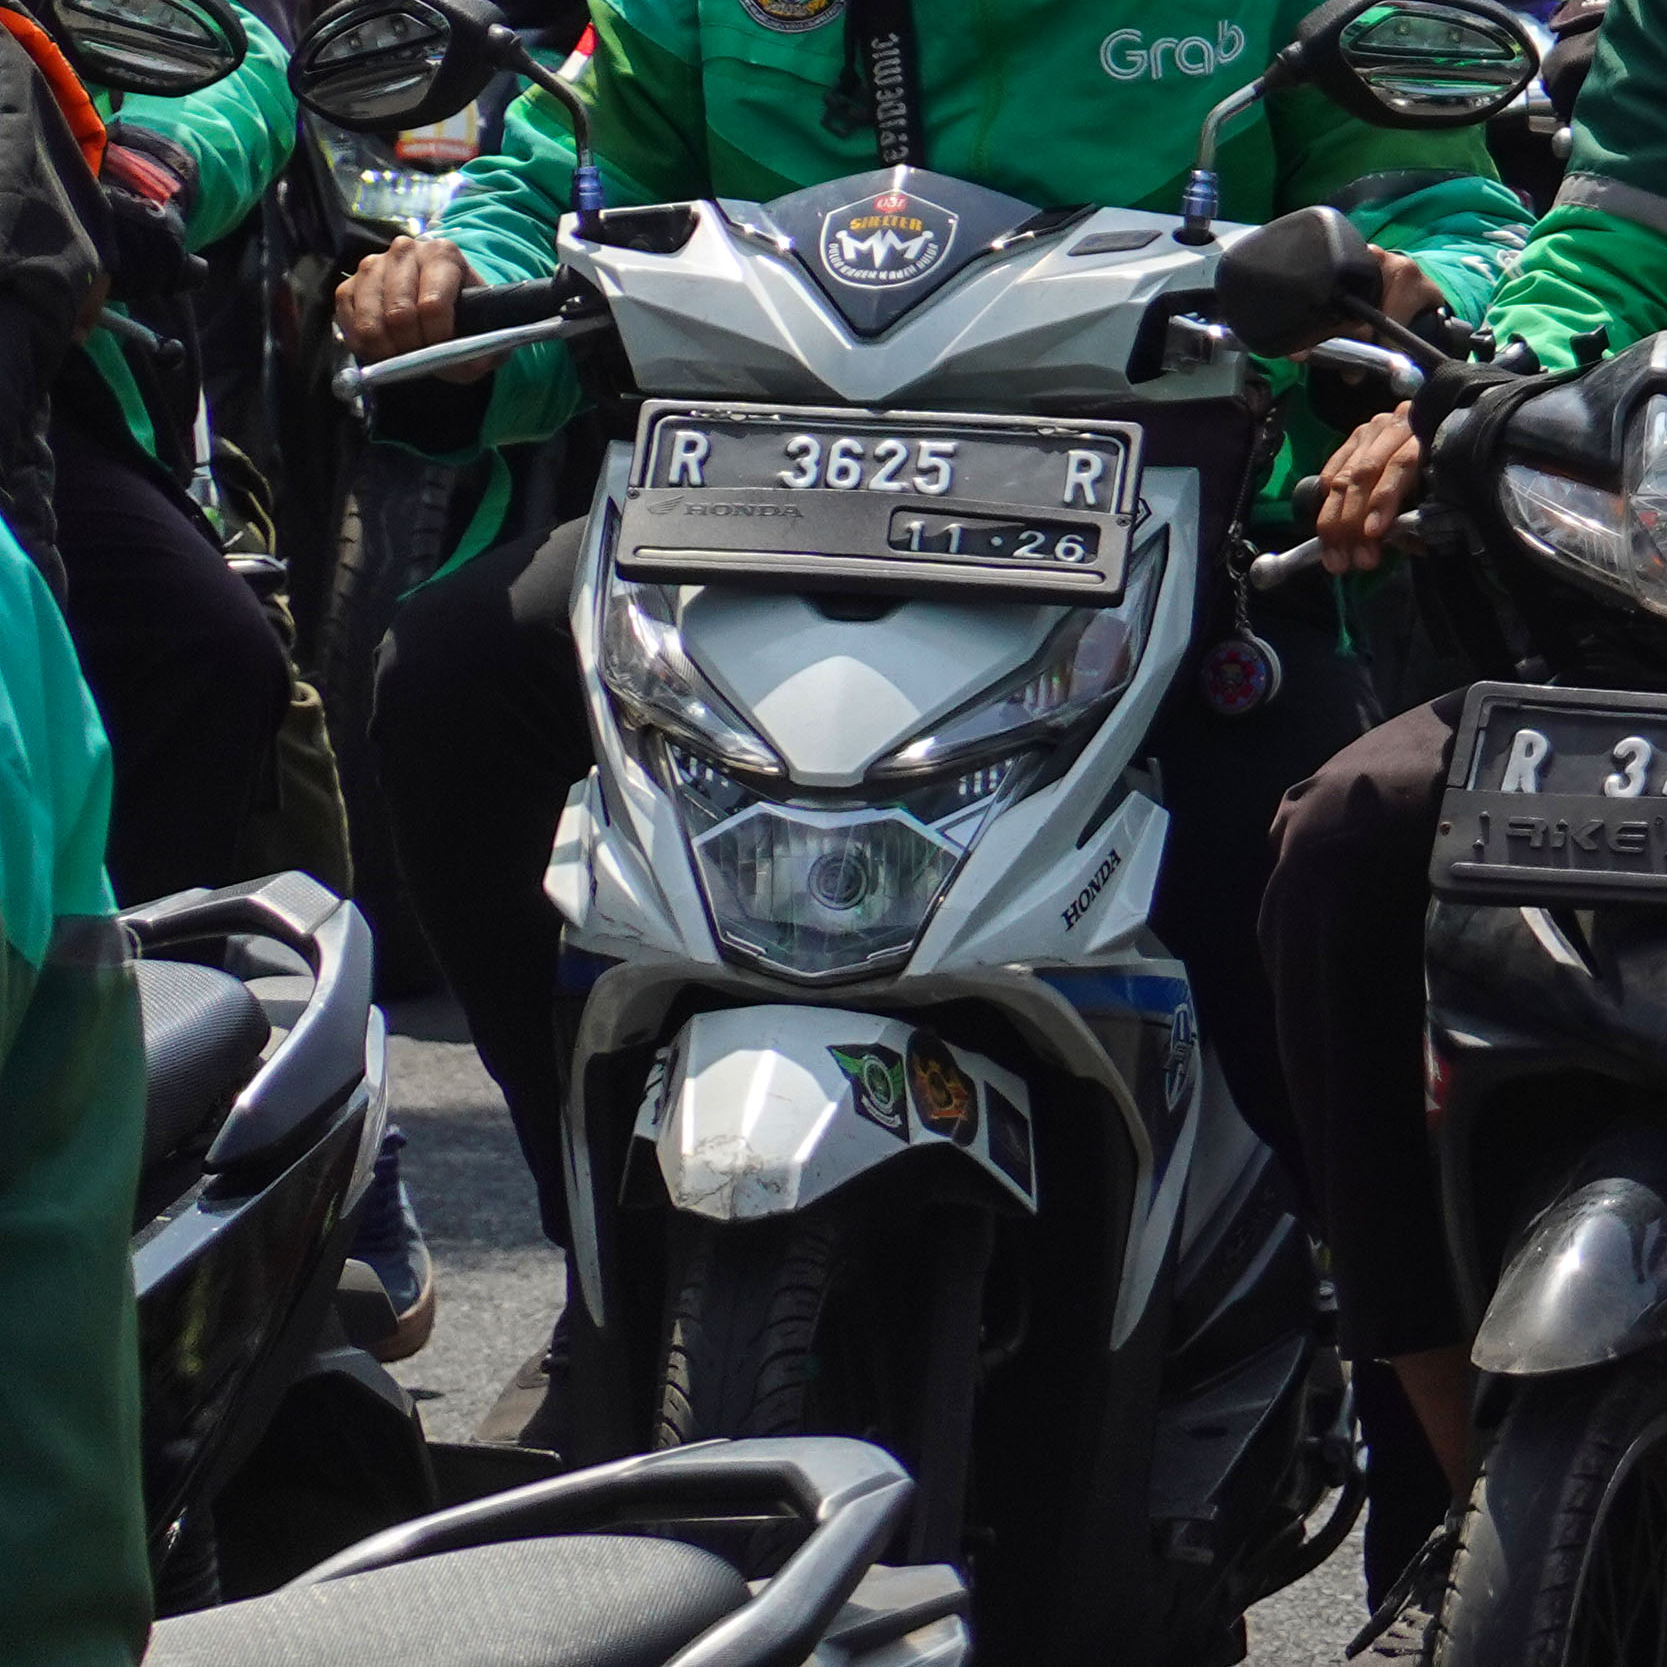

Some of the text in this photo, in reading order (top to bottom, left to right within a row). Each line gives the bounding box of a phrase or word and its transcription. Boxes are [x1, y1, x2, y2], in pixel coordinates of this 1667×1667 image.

[1100, 20, 1246, 81] Grab
[850, 214, 924, 232] SHELTER
[667, 430, 1104, 508] R 3625 R
[684, 502, 804, 519] HONDA
[1500, 728, 1551, 794] R
[1060, 849, 1121, 931] HONDA
